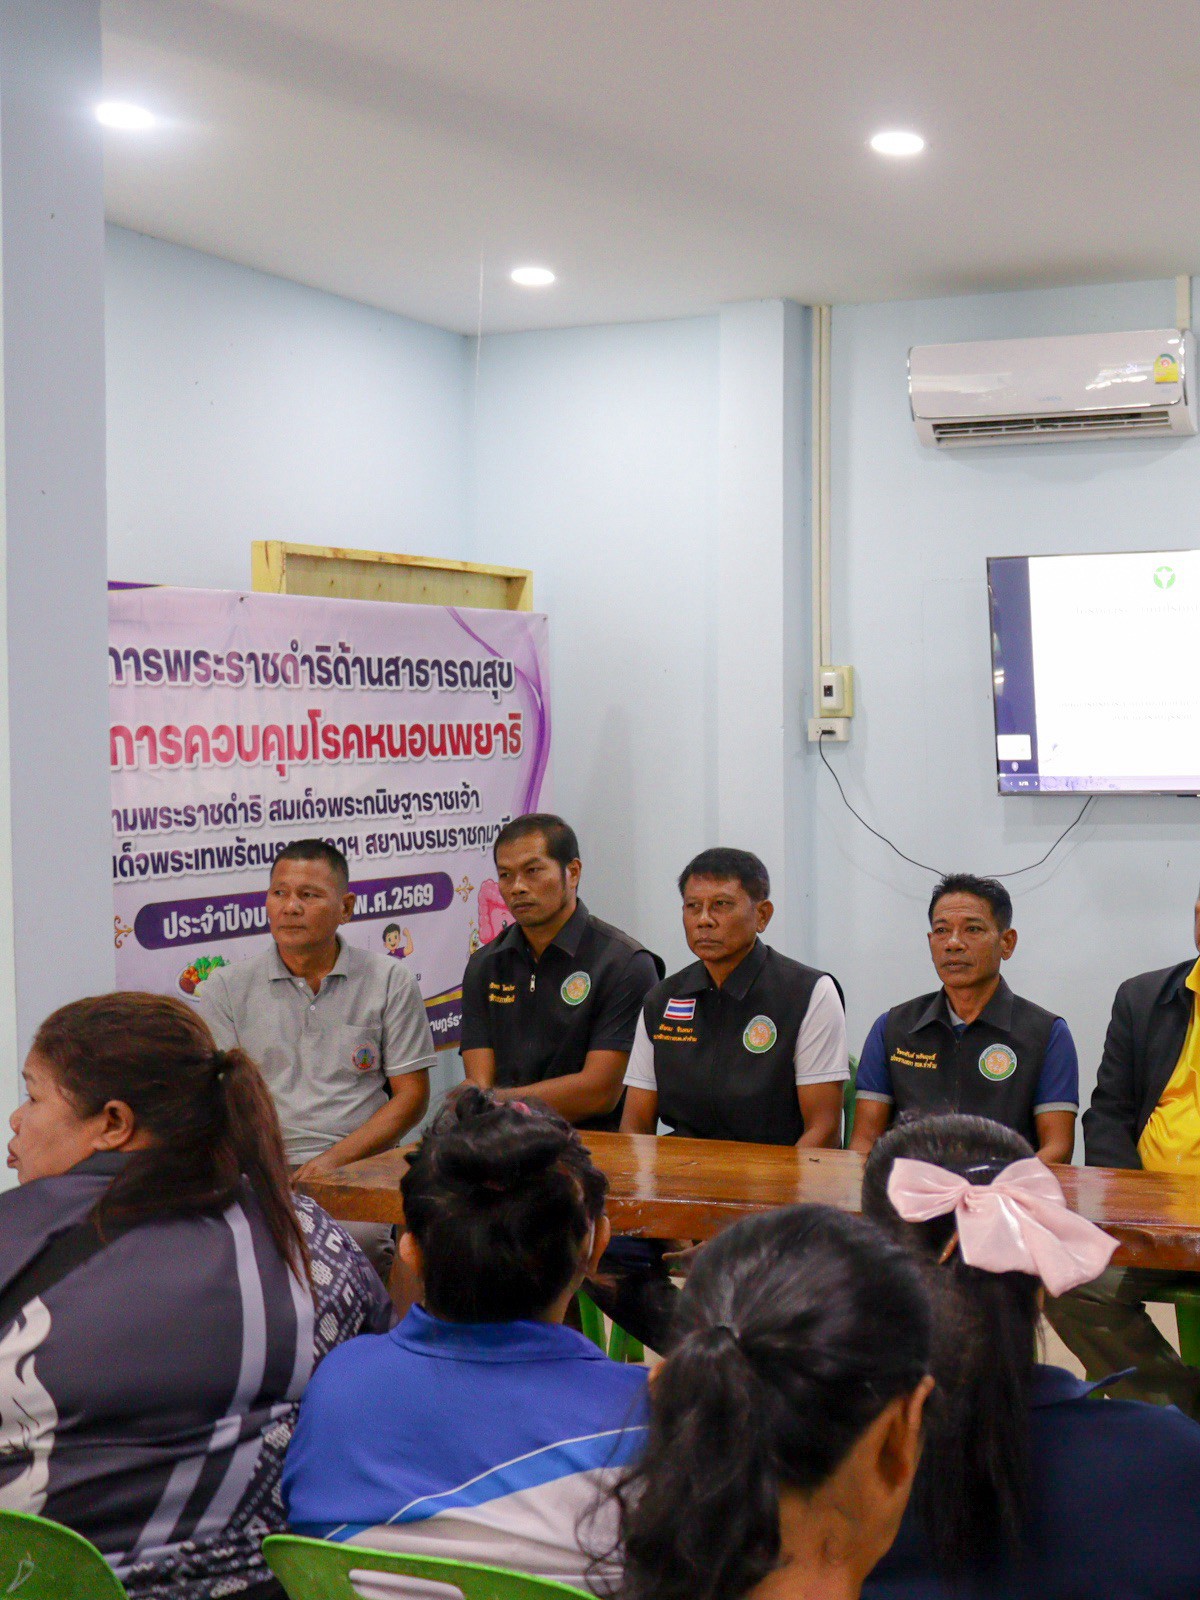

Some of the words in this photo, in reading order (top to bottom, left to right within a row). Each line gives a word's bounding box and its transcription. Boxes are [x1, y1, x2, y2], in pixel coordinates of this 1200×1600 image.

[110, 710, 523, 777] การควบคุมโรคหนอนพยาธิ
[269, 782, 480, 822] สมเด็จพระกนิษฐาราชเจ้า
[353, 883, 434, 915] พ.ศ.2569
